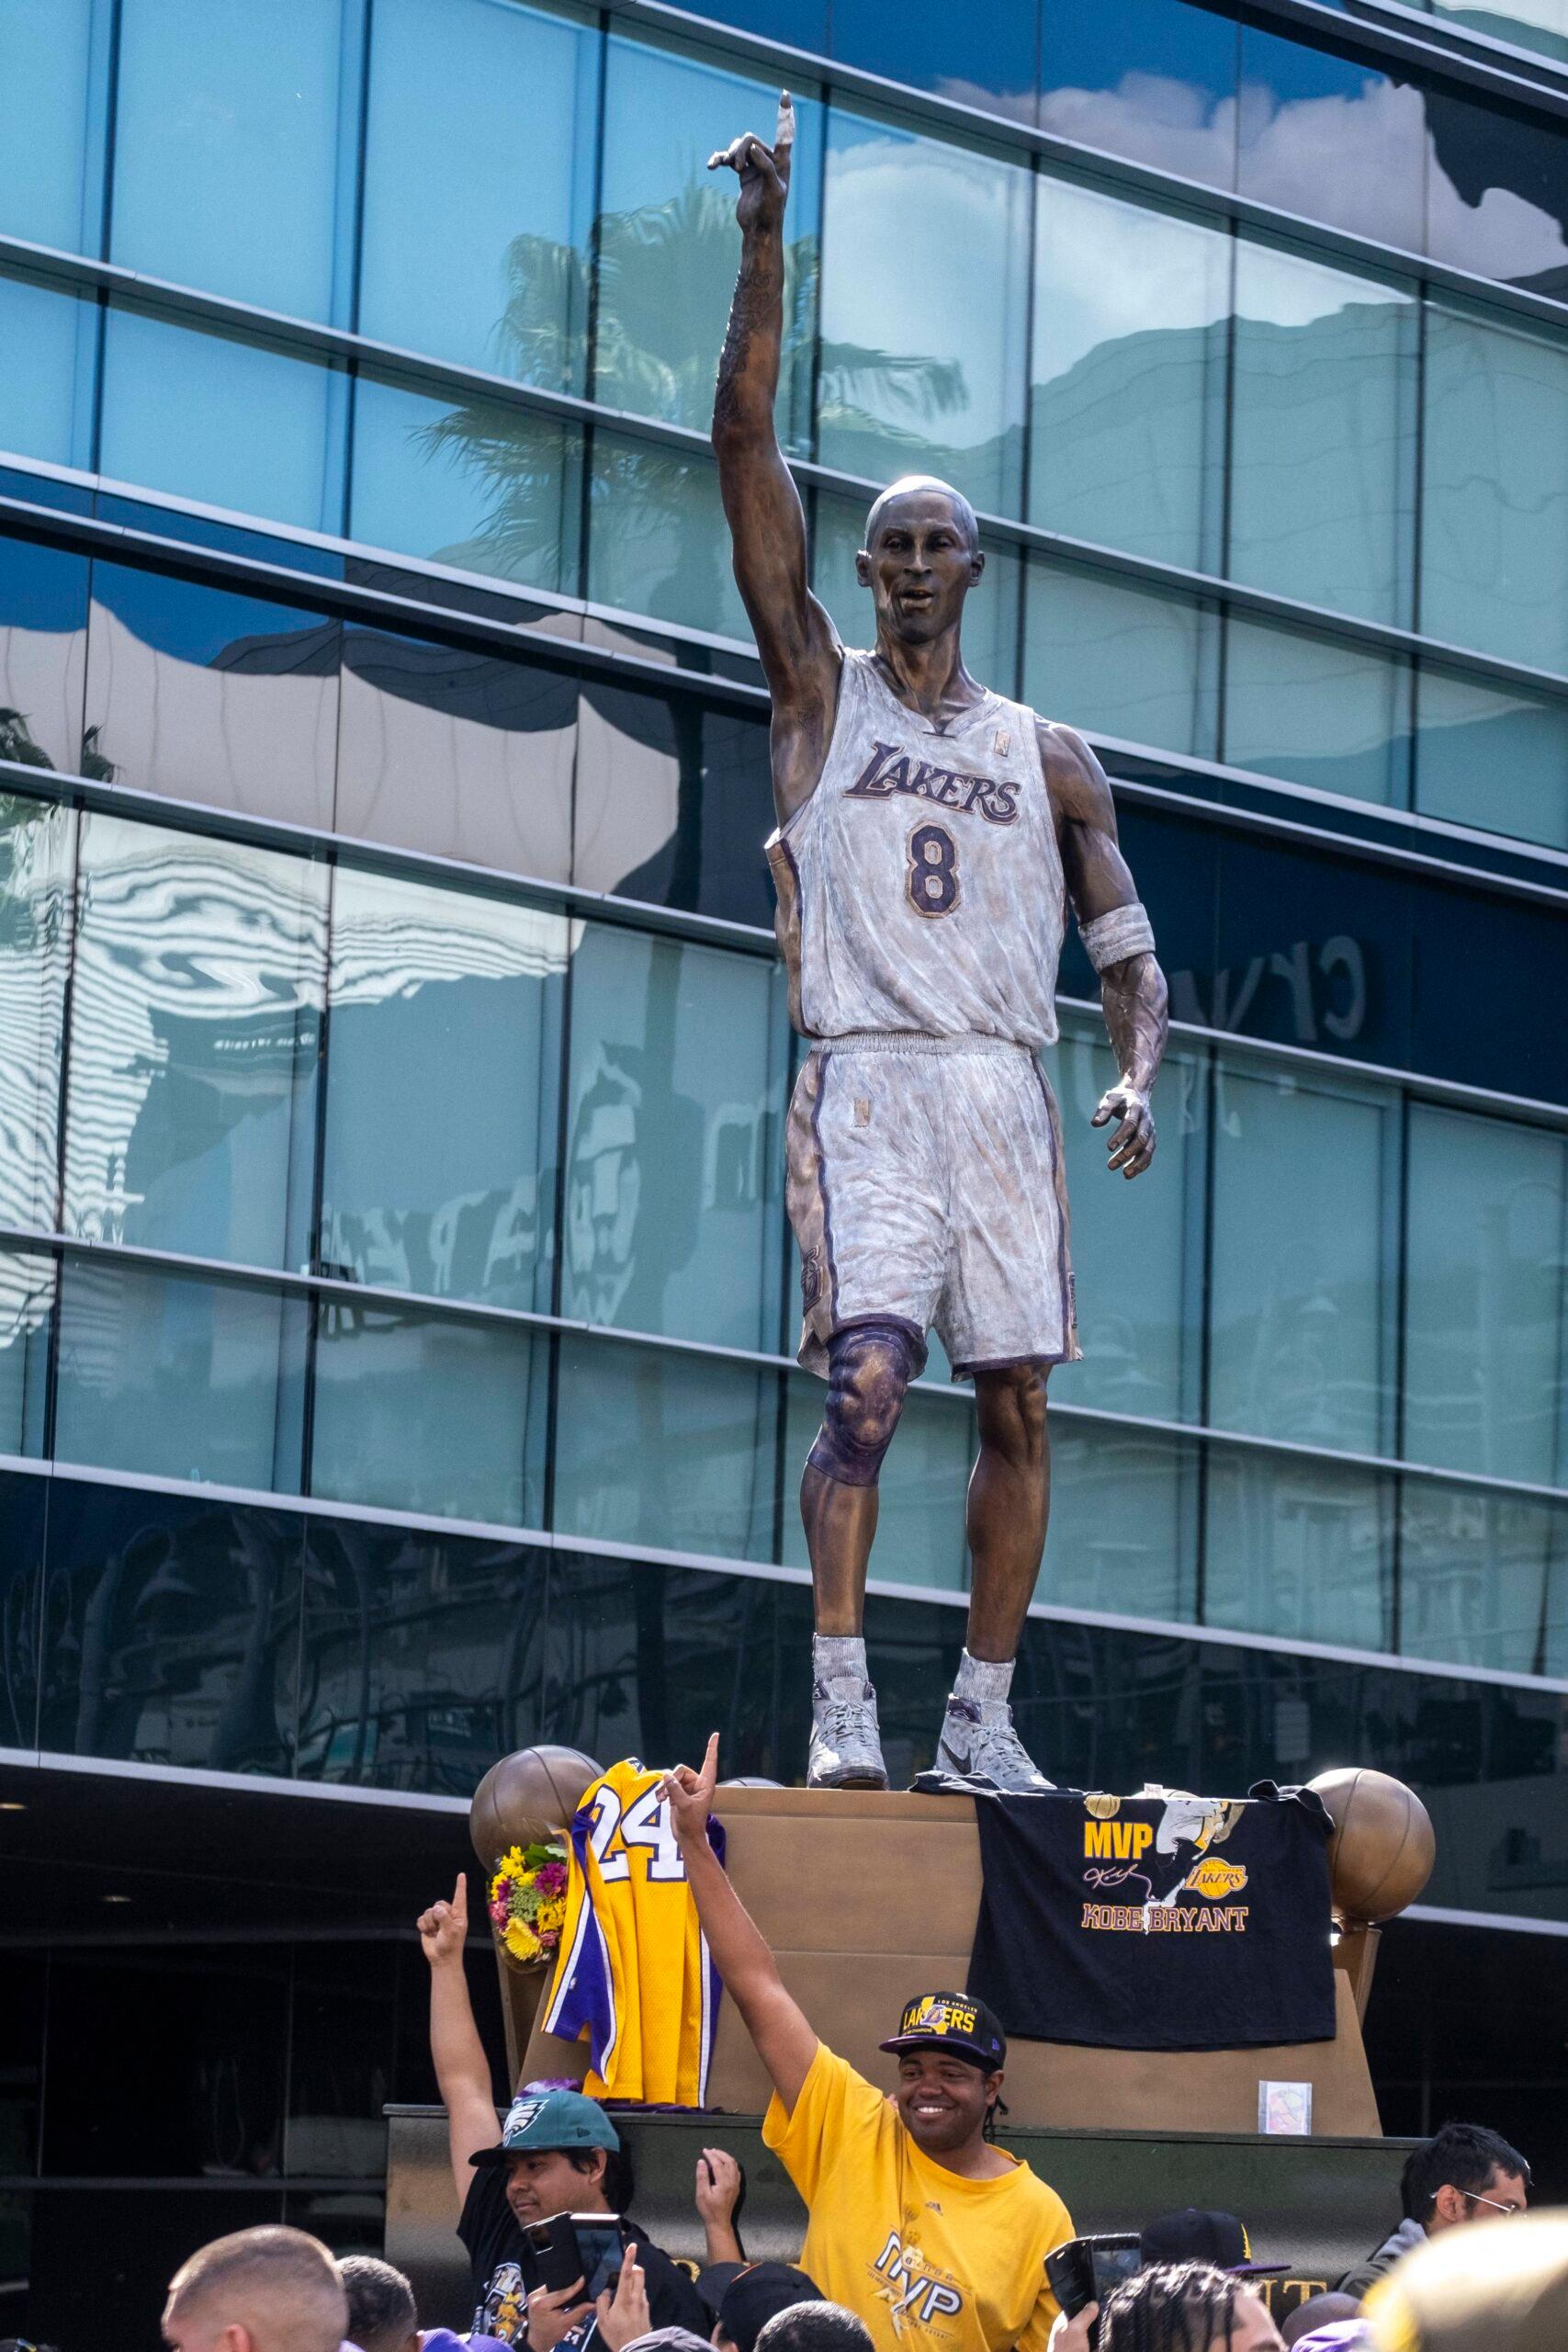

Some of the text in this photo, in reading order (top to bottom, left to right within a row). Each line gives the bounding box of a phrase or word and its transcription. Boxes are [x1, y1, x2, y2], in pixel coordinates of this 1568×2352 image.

[842, 741, 1021, 825] LAKERS
[906, 820, 961, 919] 8
[588, 1781, 687, 1883] 24
[1084, 1821, 1154, 1860] MVP
[1188, 1867, 1246, 1891] LAKERS
[1081, 1903, 1249, 1932] KOBE BRYANT
